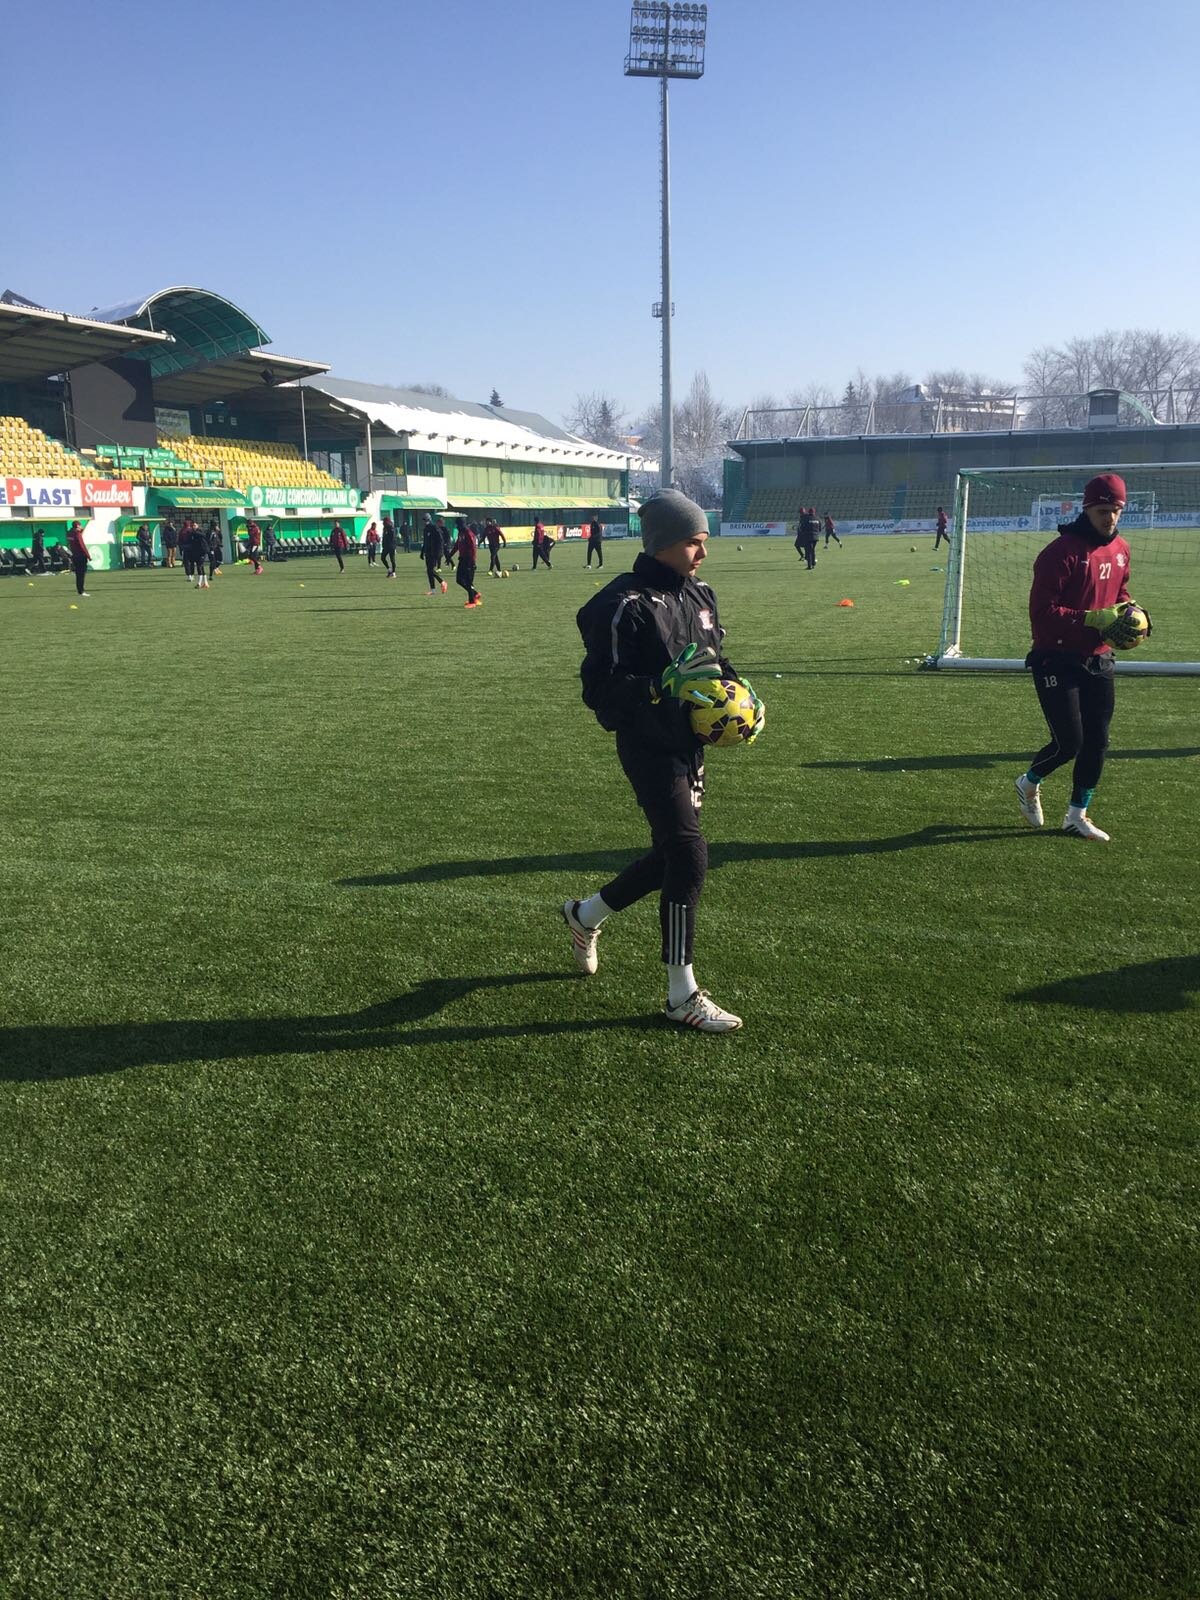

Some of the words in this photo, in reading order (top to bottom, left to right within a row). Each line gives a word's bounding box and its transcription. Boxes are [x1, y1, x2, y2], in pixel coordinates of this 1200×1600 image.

[85, 483, 130, 504] Sauber
[265, 488, 286, 505] FORZA
[287, 488, 322, 506] CONCORDIA
[966, 519, 1011, 527] Carrefour
[1099, 563, 1112, 580] 27
[1044, 675, 1058, 688] 18
